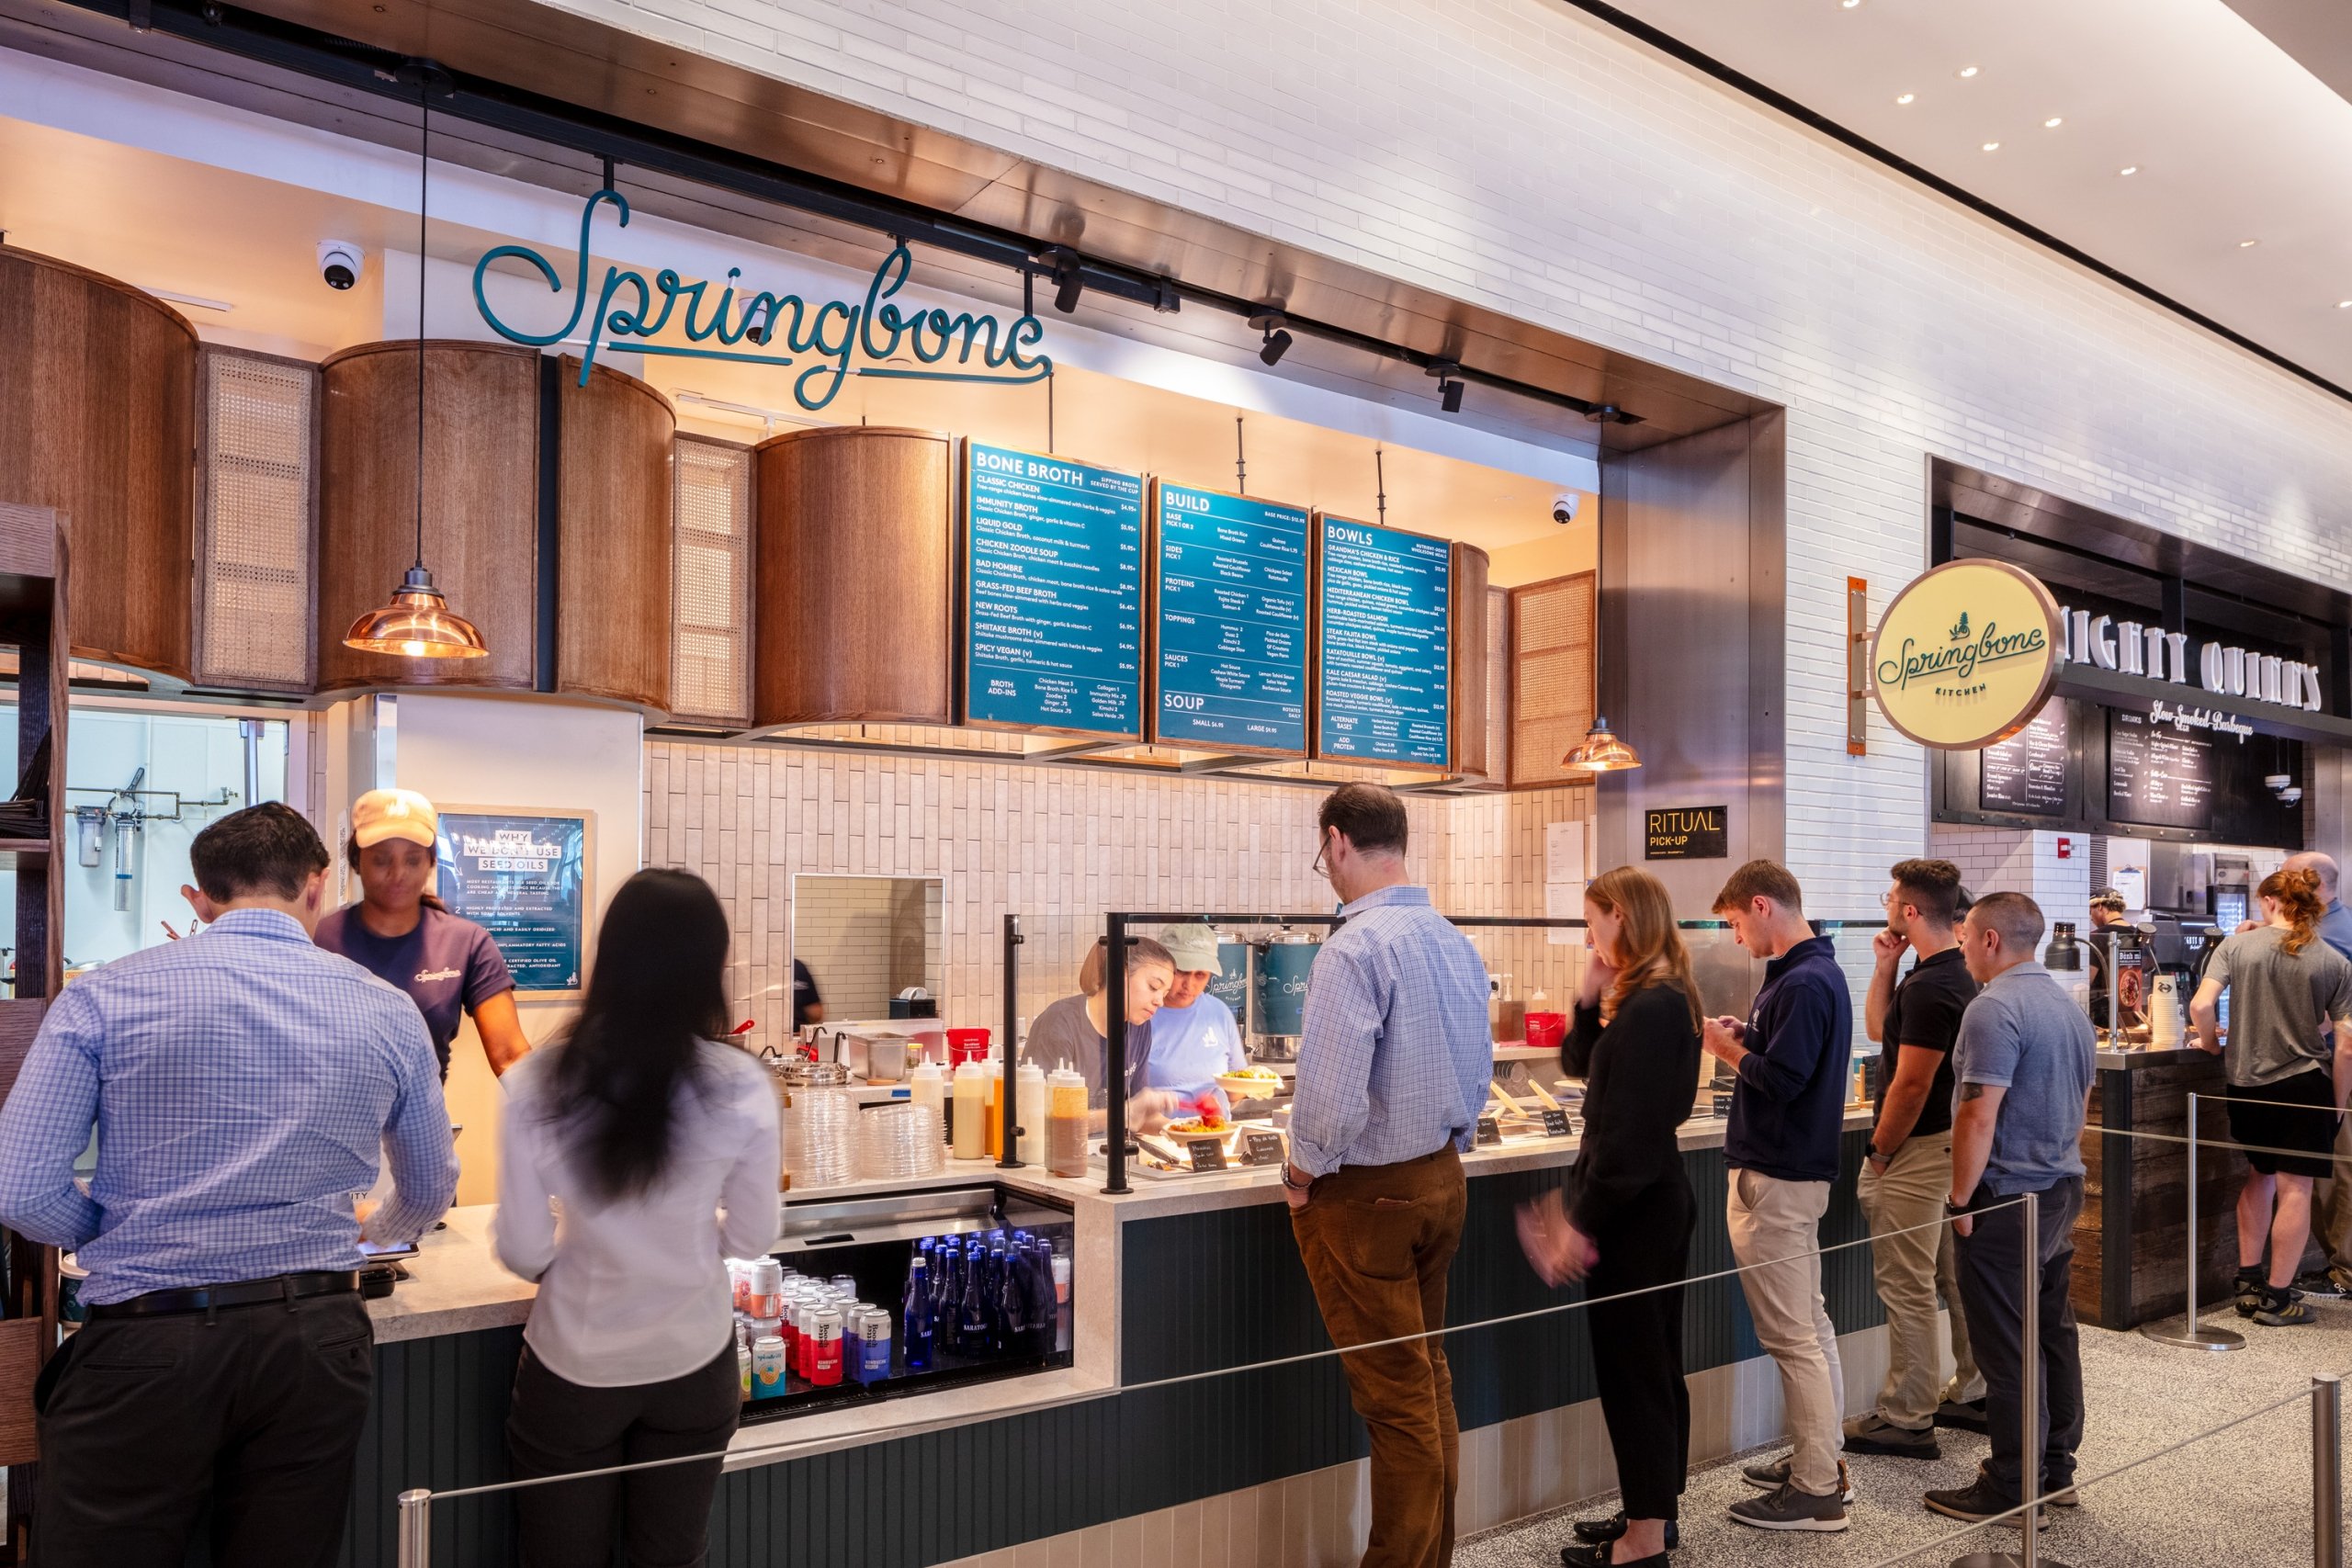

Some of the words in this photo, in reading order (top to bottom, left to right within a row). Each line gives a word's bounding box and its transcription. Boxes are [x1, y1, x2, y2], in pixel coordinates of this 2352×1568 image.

[472, 190, 1054, 411] Springbone
[978, 452, 1023, 474] BONE
[1028, 462, 1082, 486] BROTH
[978, 475, 1006, 487] CLASSIC
[1008, 481, 1039, 492] CHICKEN
[978, 497, 1012, 508] IMMUNITY
[1014, 503, 1037, 513] BROTH
[1167, 491, 1209, 512] BUILD
[1167, 513, 1182, 521] BASE
[977, 518, 1001, 527] LIQUID
[1002, 522, 1023, 531] GOLD
[1329, 525, 1373, 546] BOWLS
[977, 538, 1009, 549] CHICKEN
[1011, 544, 1038, 555] ZOODLE
[1040, 549, 1058, 558] SOUP
[1360, 551, 1383, 559] CHICKEN
[977, 559, 991, 568] BAD
[992, 562, 1023, 572] HOMBRE
[1329, 566, 1351, 574] MEXICAN
[1166, 578, 1194, 587] PROTEINS
[976, 581, 1015, 592] GRASS-FED
[1034, 589, 1057, 598] BROTH
[1328, 588, 1371, 599] MEDITERRANEAN
[1372, 594, 1394, 603] CHICKEN
[994, 604, 1017, 614] ROOTS
[1327, 608, 1366, 618] HERB-ROASTED
[1165, 615, 1195, 624] TOPPINGS
[976, 623, 1006, 633] SHIITAKE
[1008, 626, 1031, 636] BROTH
[976, 643, 995, 652] SPICY
[997, 647, 1021, 655] VEGAN
[2060, 605, 2188, 683] IGHTY
[1327, 649, 1361, 658] RATATOUILLE
[1878, 622, 2045, 690] Springbone
[991, 680, 1013, 688] BROTH
[1936, 683, 1986, 696] KITCHEN
[989, 687, 1016, 696] ADD-INS
[1327, 690, 1350, 698] ROASTED
[1165, 694, 1204, 710] SOUP
[1650, 810, 1720, 833] RITUAL
[499, 833, 528, 842] WHY
[1650, 835, 1688, 846] PICK-UP
[468, 846, 486, 854] WE
[492, 846, 529, 855] DON'
[537, 848, 558, 856] USE
[482, 860, 512, 868] SEED
[516, 861, 544, 870] OILS
[455, 906, 461, 914] 2
